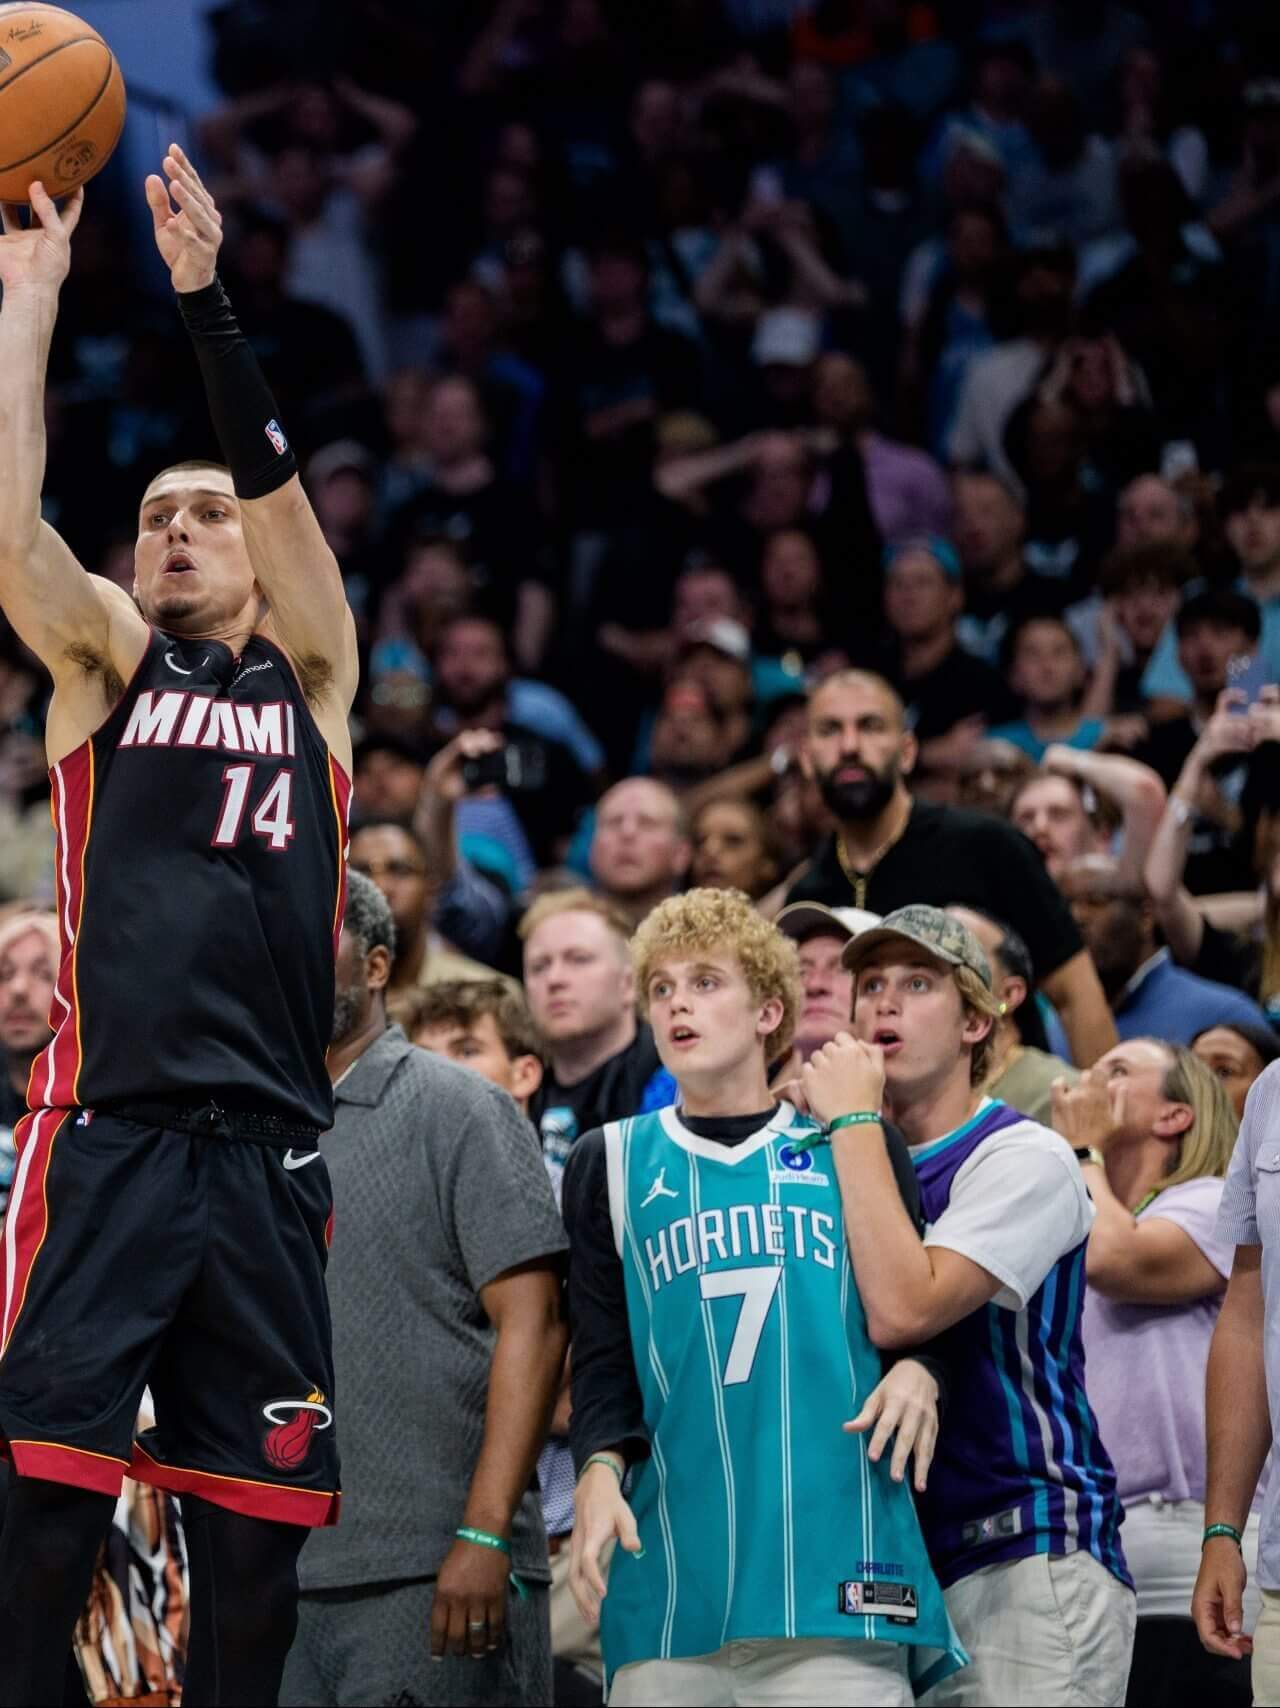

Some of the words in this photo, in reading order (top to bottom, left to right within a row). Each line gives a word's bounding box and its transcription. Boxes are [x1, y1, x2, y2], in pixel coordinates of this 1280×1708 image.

[116, 688, 296, 759] MIAMI
[210, 762, 296, 852] 14
[644, 1203, 838, 1293] HORNETS
[699, 1264, 784, 1388] 7
